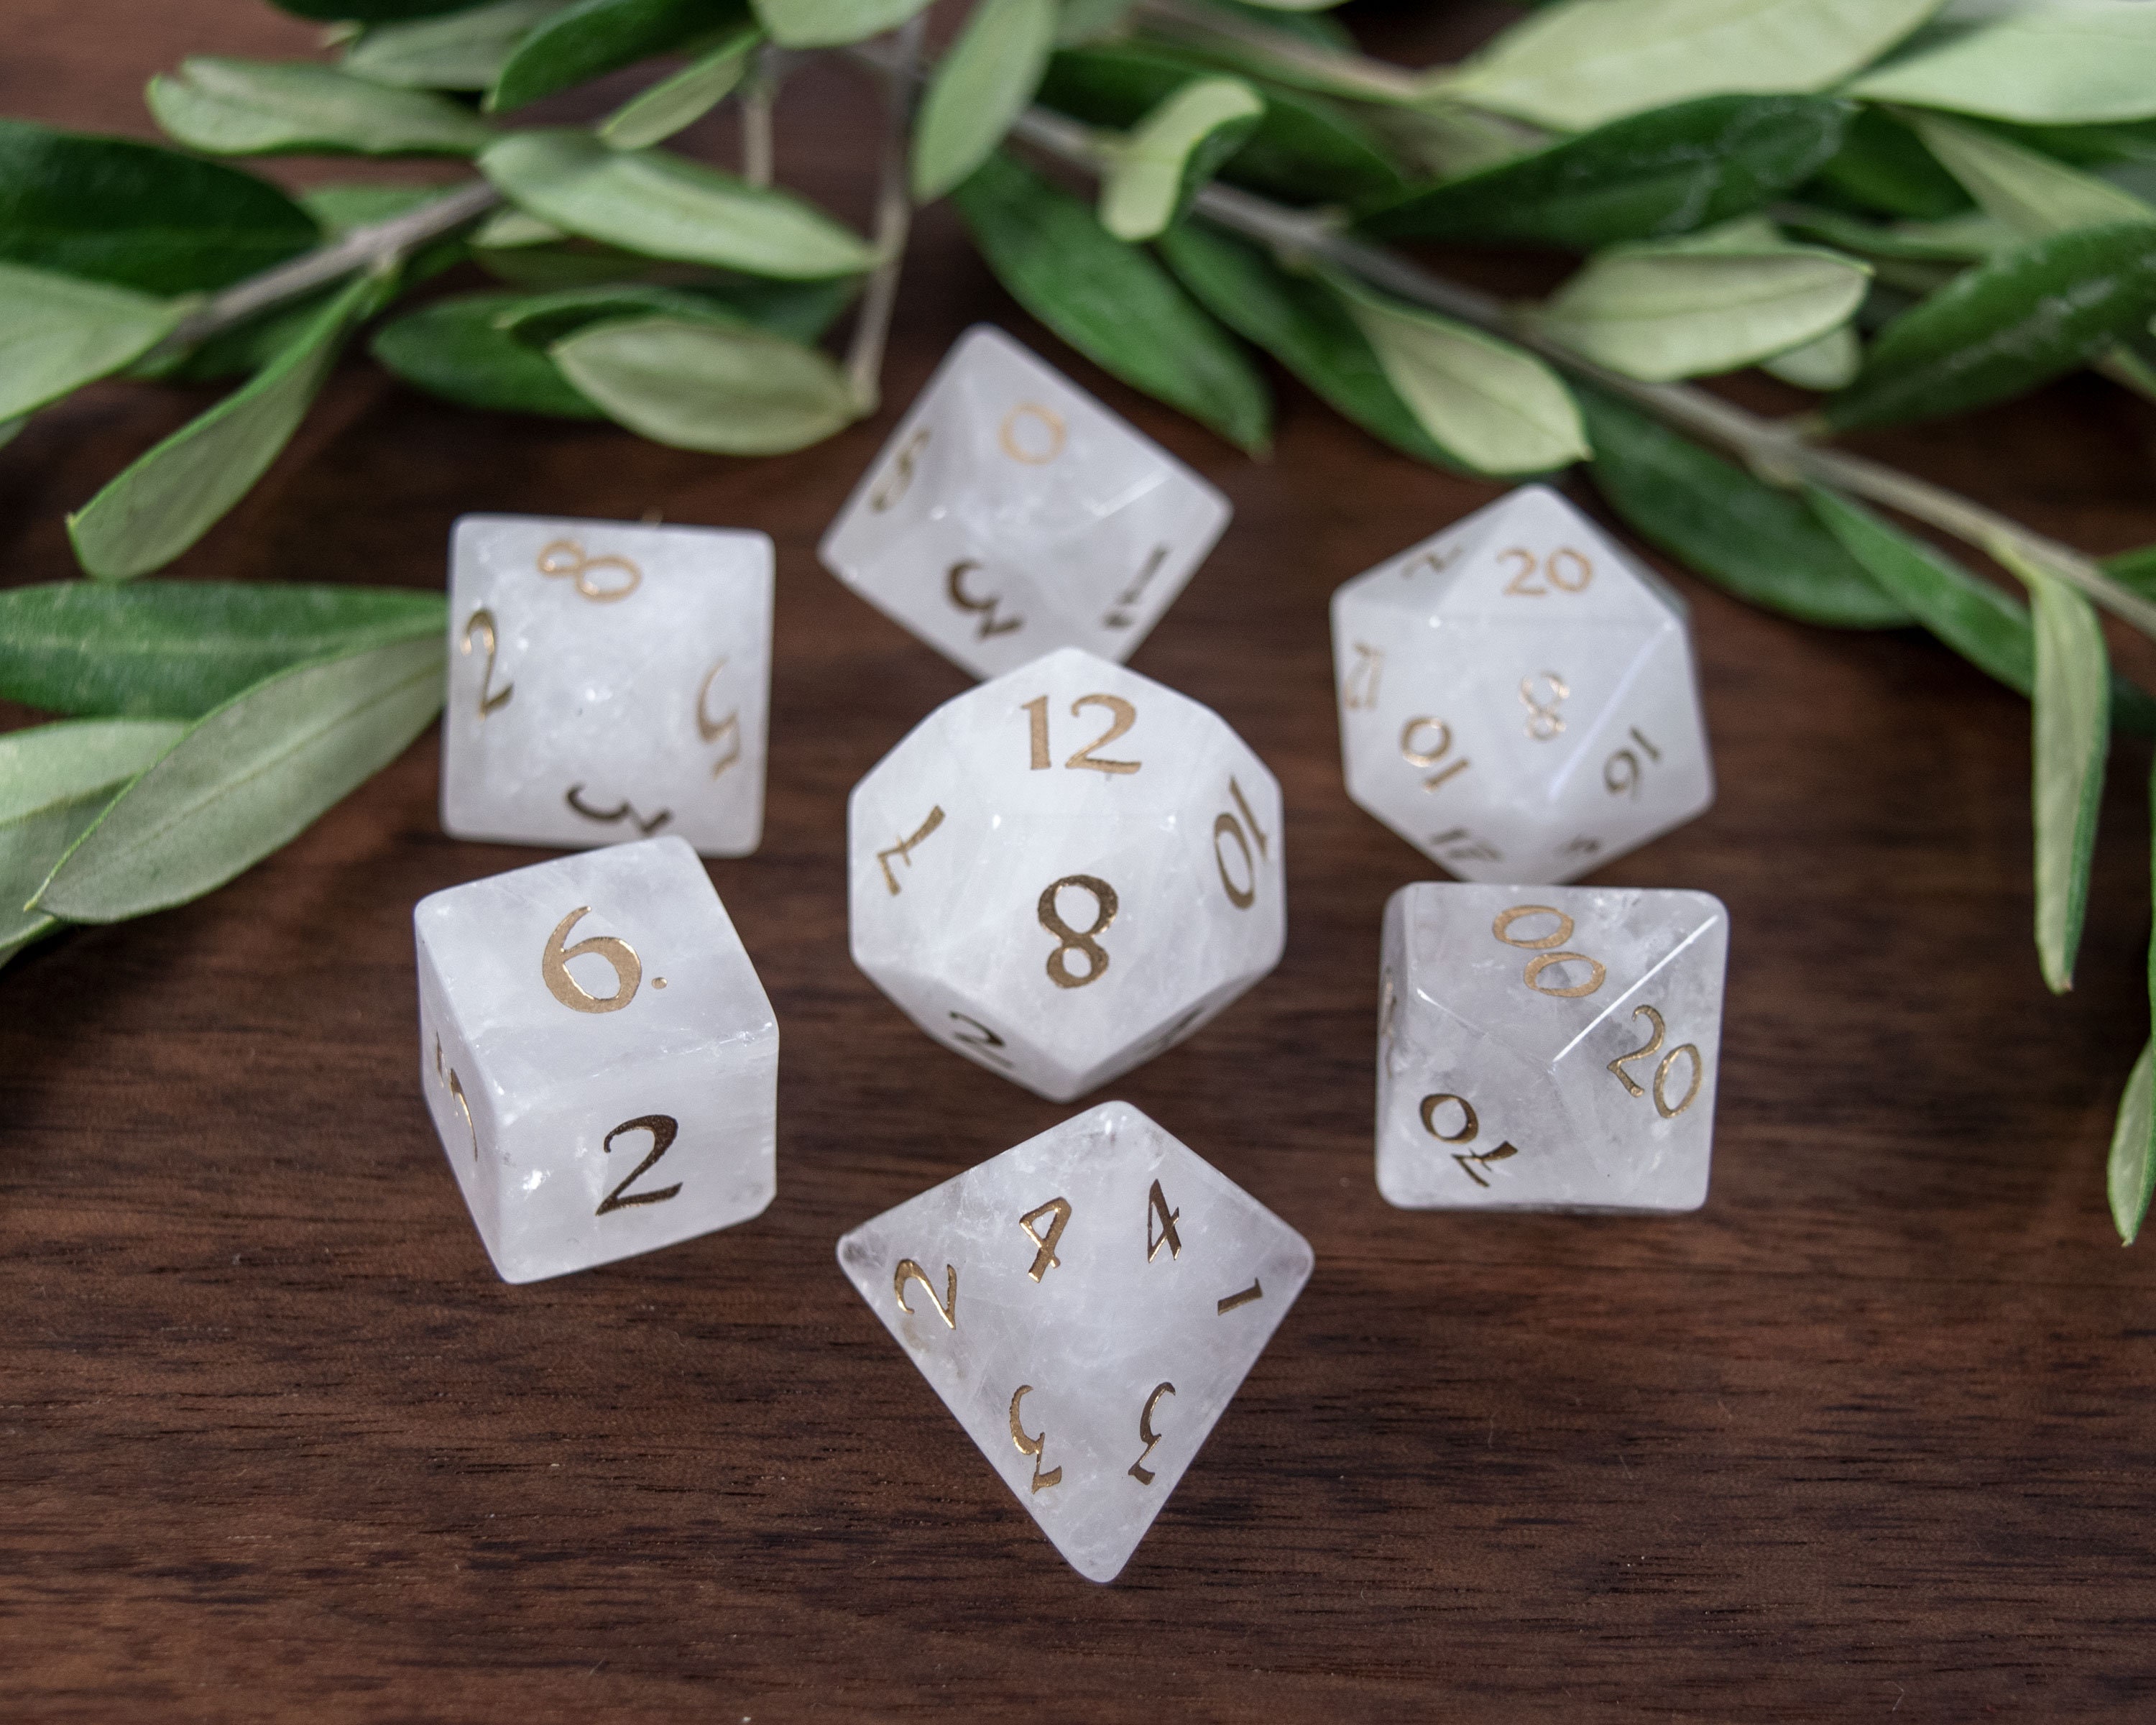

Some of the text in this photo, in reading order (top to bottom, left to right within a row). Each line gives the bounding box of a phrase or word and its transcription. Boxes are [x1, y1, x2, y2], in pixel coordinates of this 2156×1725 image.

[537, 538, 642, 604] 8
[944, 558, 1026, 641] 3
[1496, 546, 1594, 597] 20
[459, 607, 515, 722] 2
[1519, 670, 1570, 742] 8
[1021, 694, 1142, 774] 12
[1399, 714, 1471, 793] 10
[1214, 776, 1268, 911] 10
[1038, 874, 1119, 988] 8
[1606, 1003, 1703, 1119] 20
[594, 1113, 684, 1217] 2
[1419, 1093, 1519, 1188] 70
[1019, 1196, 1073, 1284] 4
[1147, 1178, 1182, 1264] 4
[894, 1259, 958, 1330] 2
[1217, 1276, 1263, 1316] 1
